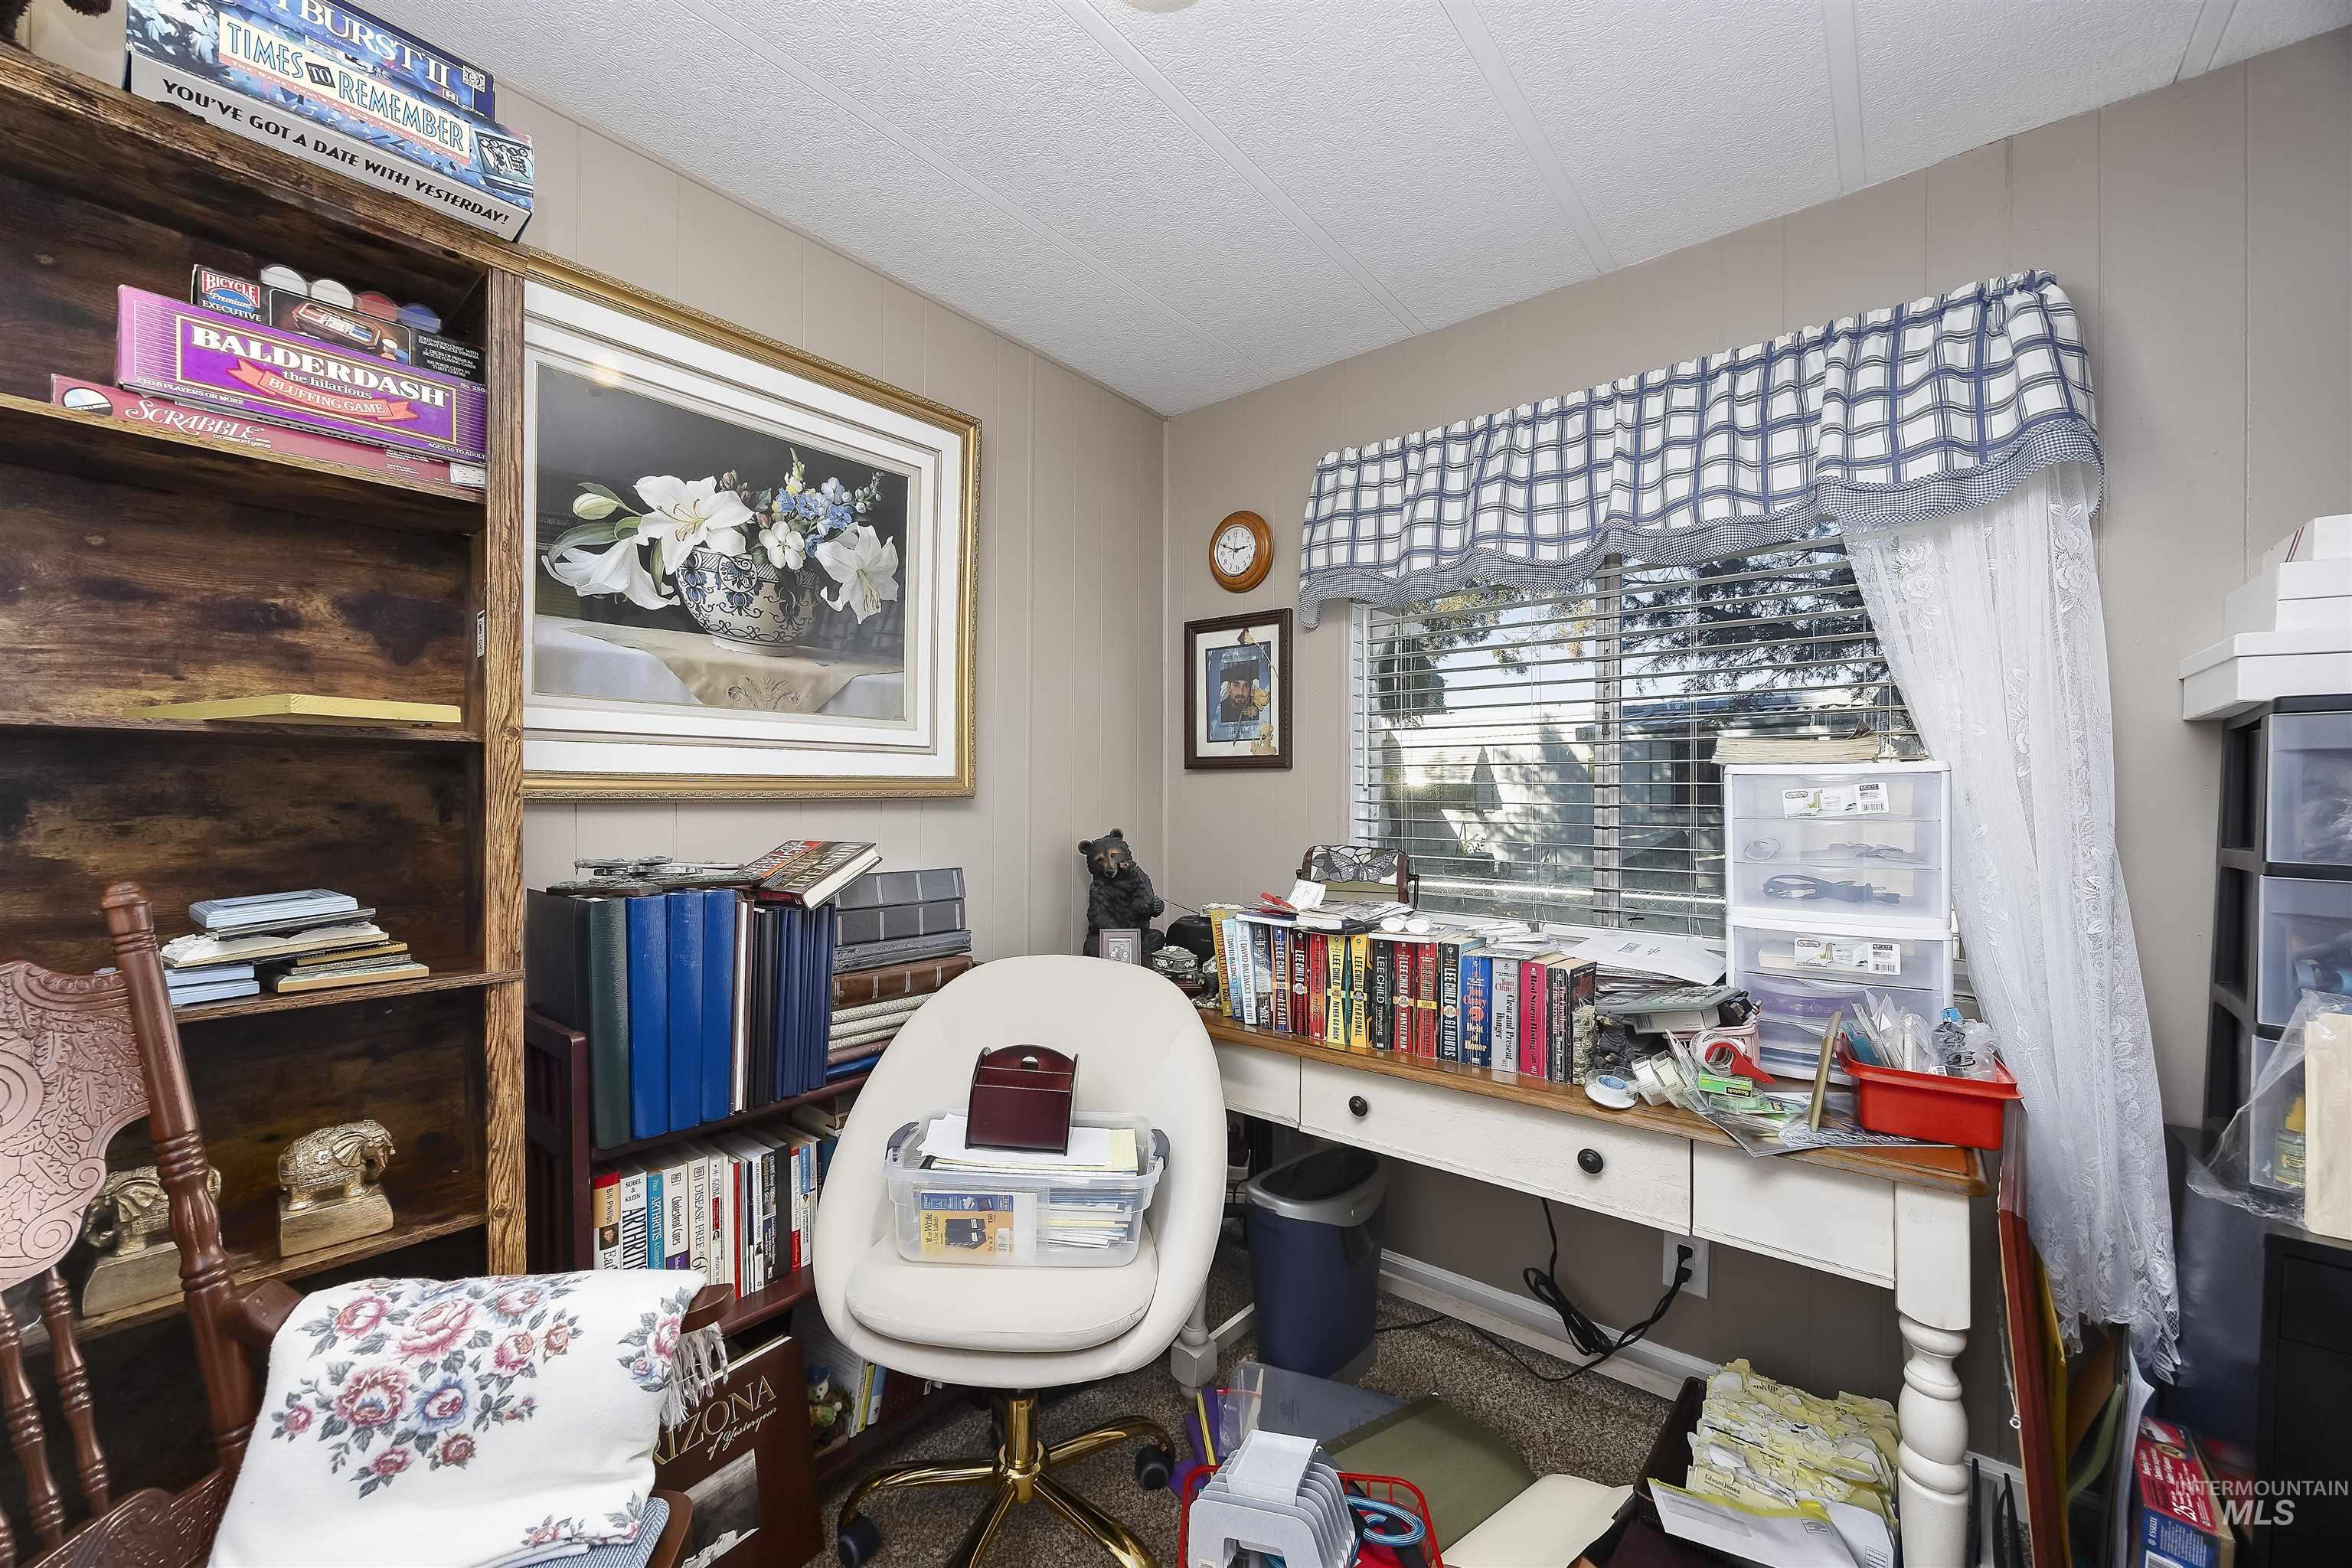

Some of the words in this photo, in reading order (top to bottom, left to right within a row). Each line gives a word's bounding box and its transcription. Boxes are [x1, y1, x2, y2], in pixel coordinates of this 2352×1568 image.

[227, 21, 304, 80] TIMES
[308, 64, 332, 85] TO
[339, 70, 464, 152] REMEMBER
[162, 78, 242, 122] YOU'VE
[249, 115, 291, 139] GOT
[292, 133, 308, 148] A
[313, 139, 361, 168] DATE
[364, 158, 410, 187] WITH
[415, 178, 510, 225] YESTERDAY!
[204, 272, 258, 305] BICYCLE
[202, 300, 262, 322] EXECUTIVE
[210, 292, 253, 309] Premium
[433, 339, 449, 348] WOOD
[466, 348, 479, 357] WITH
[191, 325, 446, 408] BALDERDASH
[142, 377, 154, 386] TO
[162, 382, 204, 397] PLAYERS
[205, 391, 218, 400] OR
[219, 394, 245, 406] MORE
[268, 376, 342, 410] BLUFFING
[344, 400, 387, 415] GAME
[283, 370, 308, 384] the
[311, 374, 374, 400] hilarious
[125, 400, 261, 441] SCRABBLE
[212, 434, 251, 447] crossword
[250, 439, 272, 449] game
[428, 442, 447, 451] AGES
[783, 844, 863, 888] TREASON
[1214, 923, 1225, 946] DAVID
[1227, 938, 1236, 956] DAVID
[1241, 943, 1250, 962] DAVID
[1276, 946, 1285, 960] LEE
[1295, 949, 1305, 963] LEE
[1217, 949, 1228, 985] BALDACCI
[1229, 956, 1238, 984] BALDACCI
[1276, 960, 1285, 981] CHILD
[1332, 954, 1341, 966] LEE
[1354, 956, 1363, 969] LEE
[1399, 960, 1408, 973] LEE
[1421, 963, 1432, 978] LEE
[1243, 963, 1251, 994] BALDACCI
[1295, 963, 1305, 982] CHILD
[1332, 967, 1341, 986] CHILD
[1354, 969, 1363, 988] CHILD
[1444, 968, 1456, 981] LEE
[1377, 975, 1385, 1004] CHILD
[1399, 974, 1408, 995] CHILD
[1421, 978, 1433, 999] CHILD
[1444, 982, 1456, 1004] CHILD
[1494, 982, 1517, 994] Clancy
[1277, 998, 1286, 1025] AFFAIR
[1506, 995, 1516, 1012] Clear
[1332, 1018, 1340, 1028] GO
[1354, 1003, 1363, 1037] PERSONAL
[1444, 1019, 1455, 1027] 61
[1466, 1022, 1483, 1033] Debt
[1494, 1011, 1505, 1039] Danger
[1506, 1013, 1515, 1030] and
[1444, 1028, 1456, 1057] HOURS
[1465, 1040, 1488, 1052] Honor
[1472, 1033, 1479, 1041] of
[1505, 1031, 1514, 1060] Present
[1726, 1087, 1752, 1097] Scotch
[625, 1178, 642, 1188] SOBEL
[625, 1193, 642, 1203] KLEIN
[694, 1184, 705, 1223] DISEASE
[606, 1200, 614, 1224] Phillips
[651, 1197, 662, 1241] ARTHRITIS
[671, 1196, 683, 1228] Cholesterol
[924, 1213, 933, 1231] Write
[622, 1206, 647, 1270] ARTHRITI
[671, 1229, 682, 1246] Cures
[694, 1224, 705, 1250] FREE
[706, 1434, 723, 1461] of
[722, 1406, 777, 1452] Yesteryear
[1704, 1472, 1724, 1486] Edward
[1723, 1481, 1741, 1495] Jones
[2173, 1504, 2197, 1523] 25
